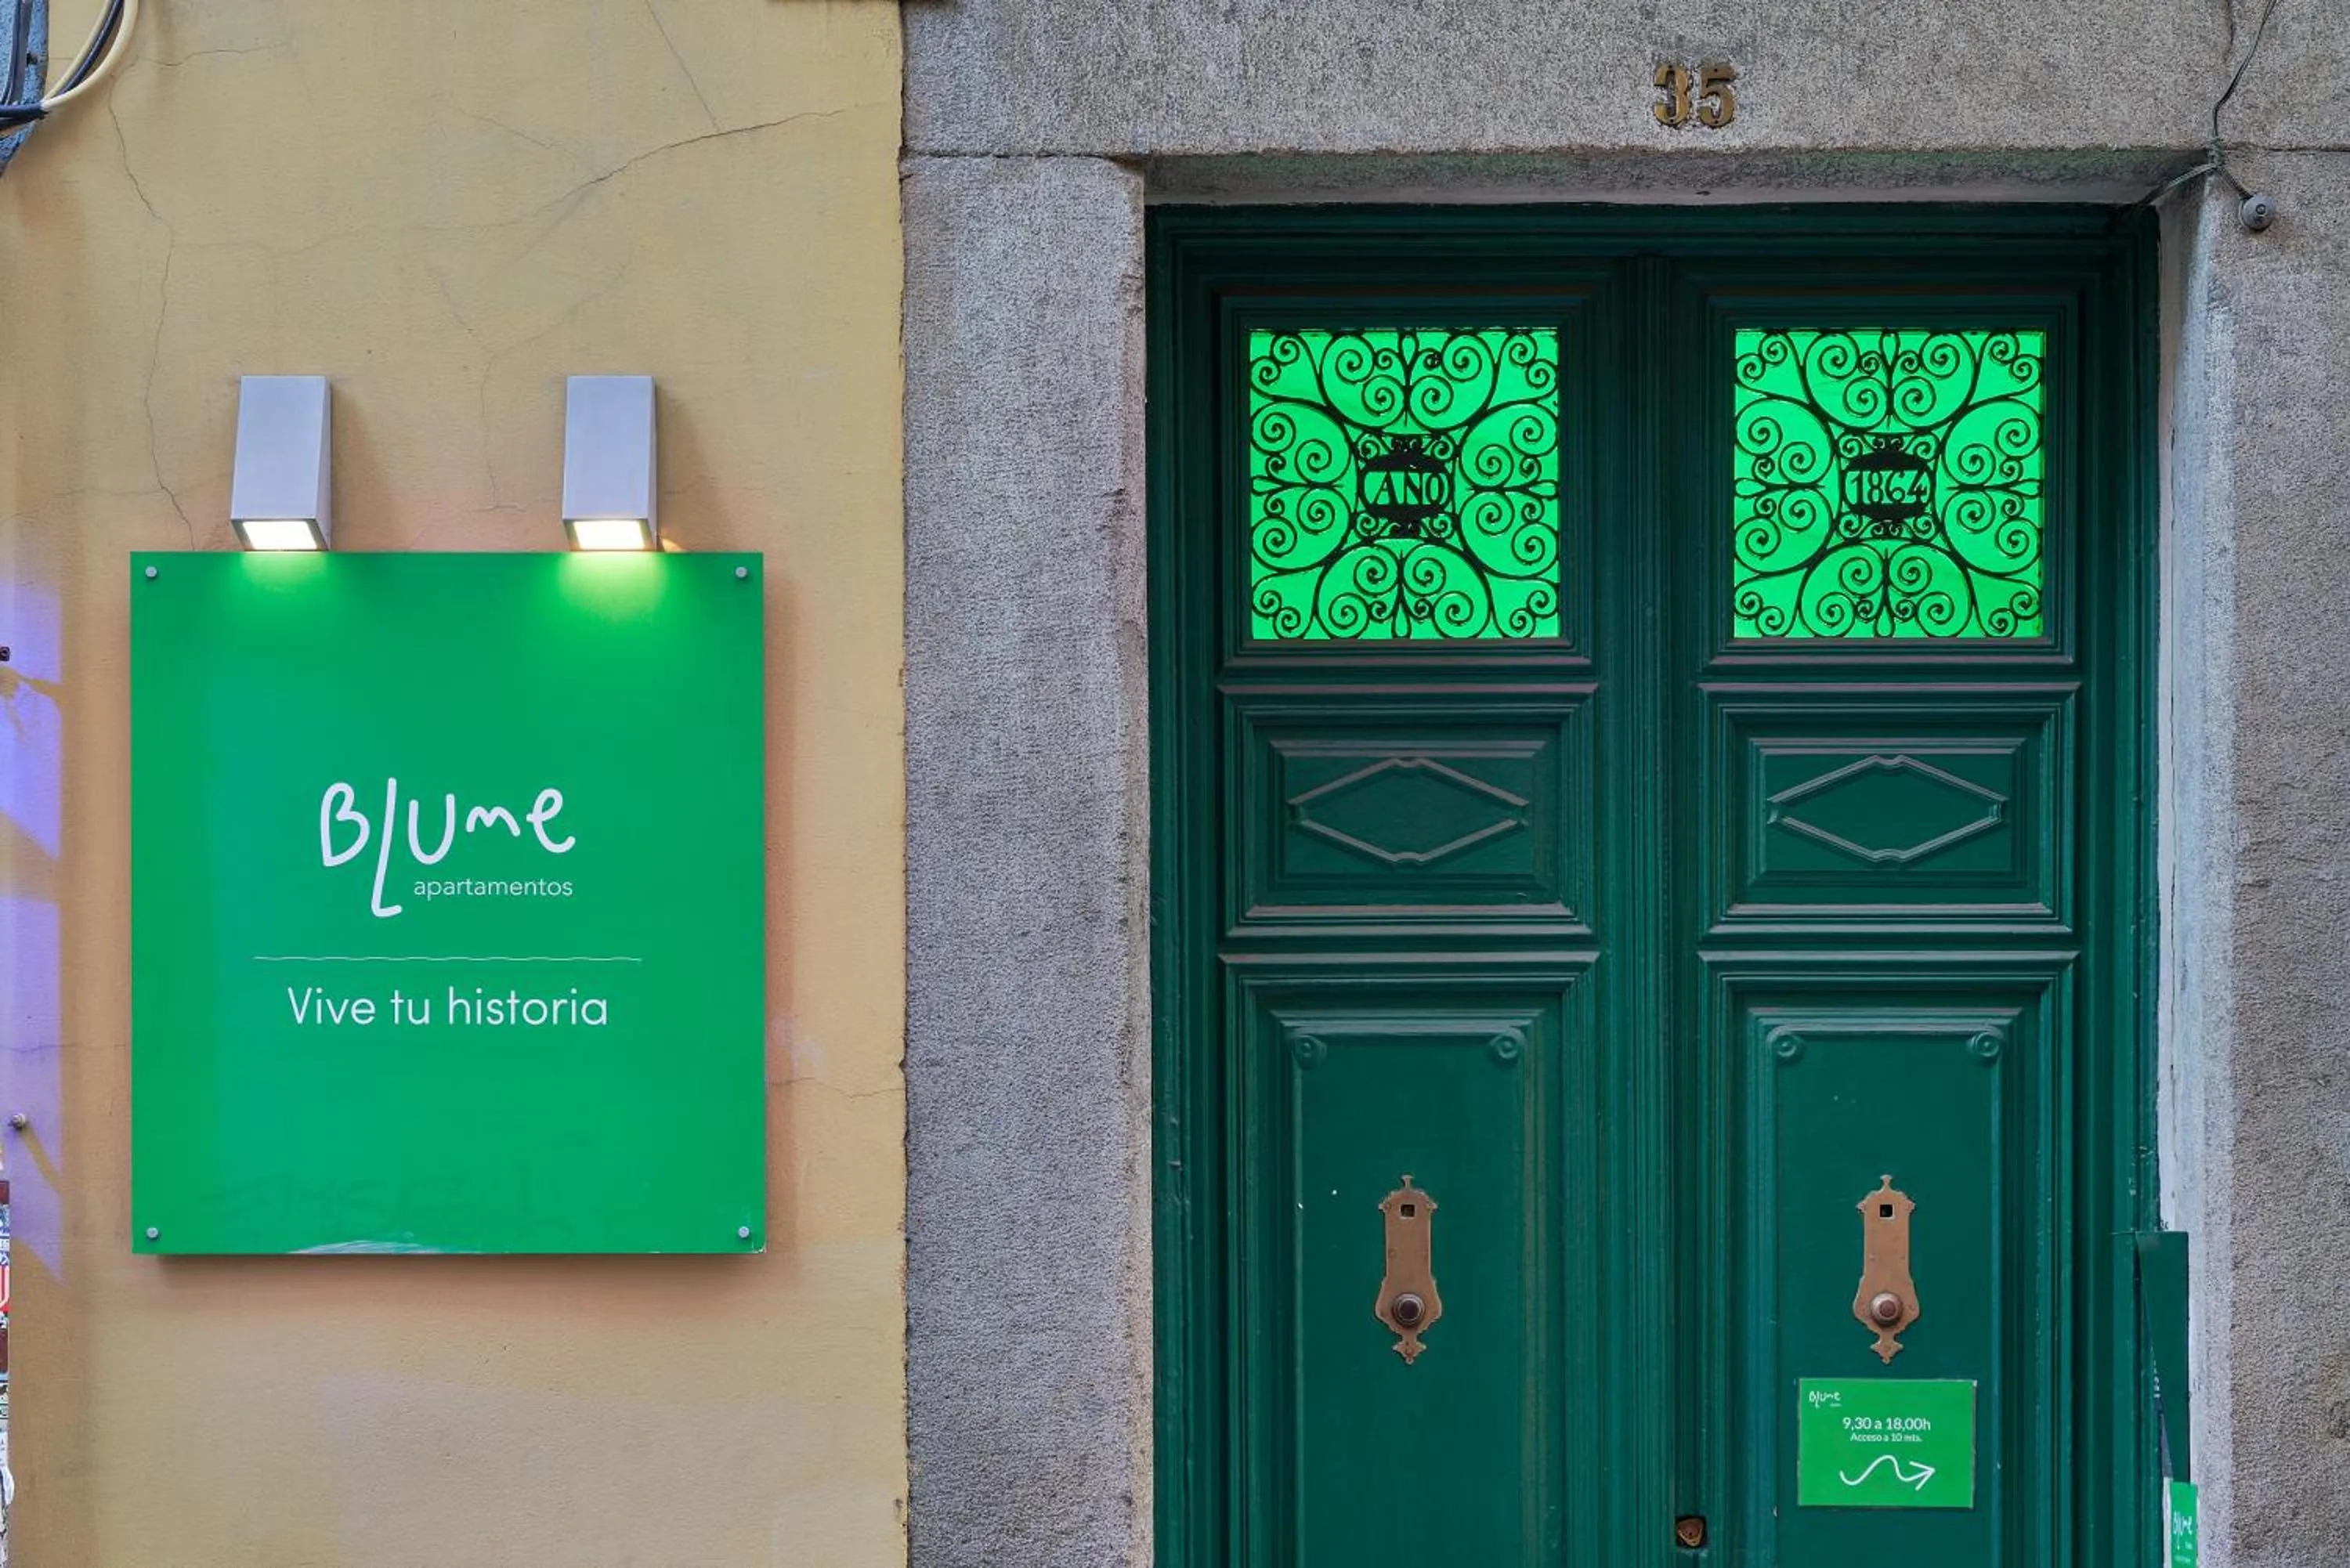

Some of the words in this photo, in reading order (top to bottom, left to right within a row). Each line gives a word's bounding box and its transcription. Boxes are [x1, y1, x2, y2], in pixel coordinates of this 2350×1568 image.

[1653, 63, 1735, 128] 35
[1850, 469, 1928, 506] 1864
[413, 877, 573, 901] apartamentos
[287, 986, 376, 1025] Vive
[390, 989, 431, 1025] tu
[448, 985, 608, 1026] historia
[1842, 1416, 1872, 1431] 9,30
[1874, 1419, 1882, 1430] a
[1885, 1416, 1931, 1432] 18,00h
[1849, 1433, 1882, 1442] Acceso
[1891, 1433, 1903, 1442] 10
